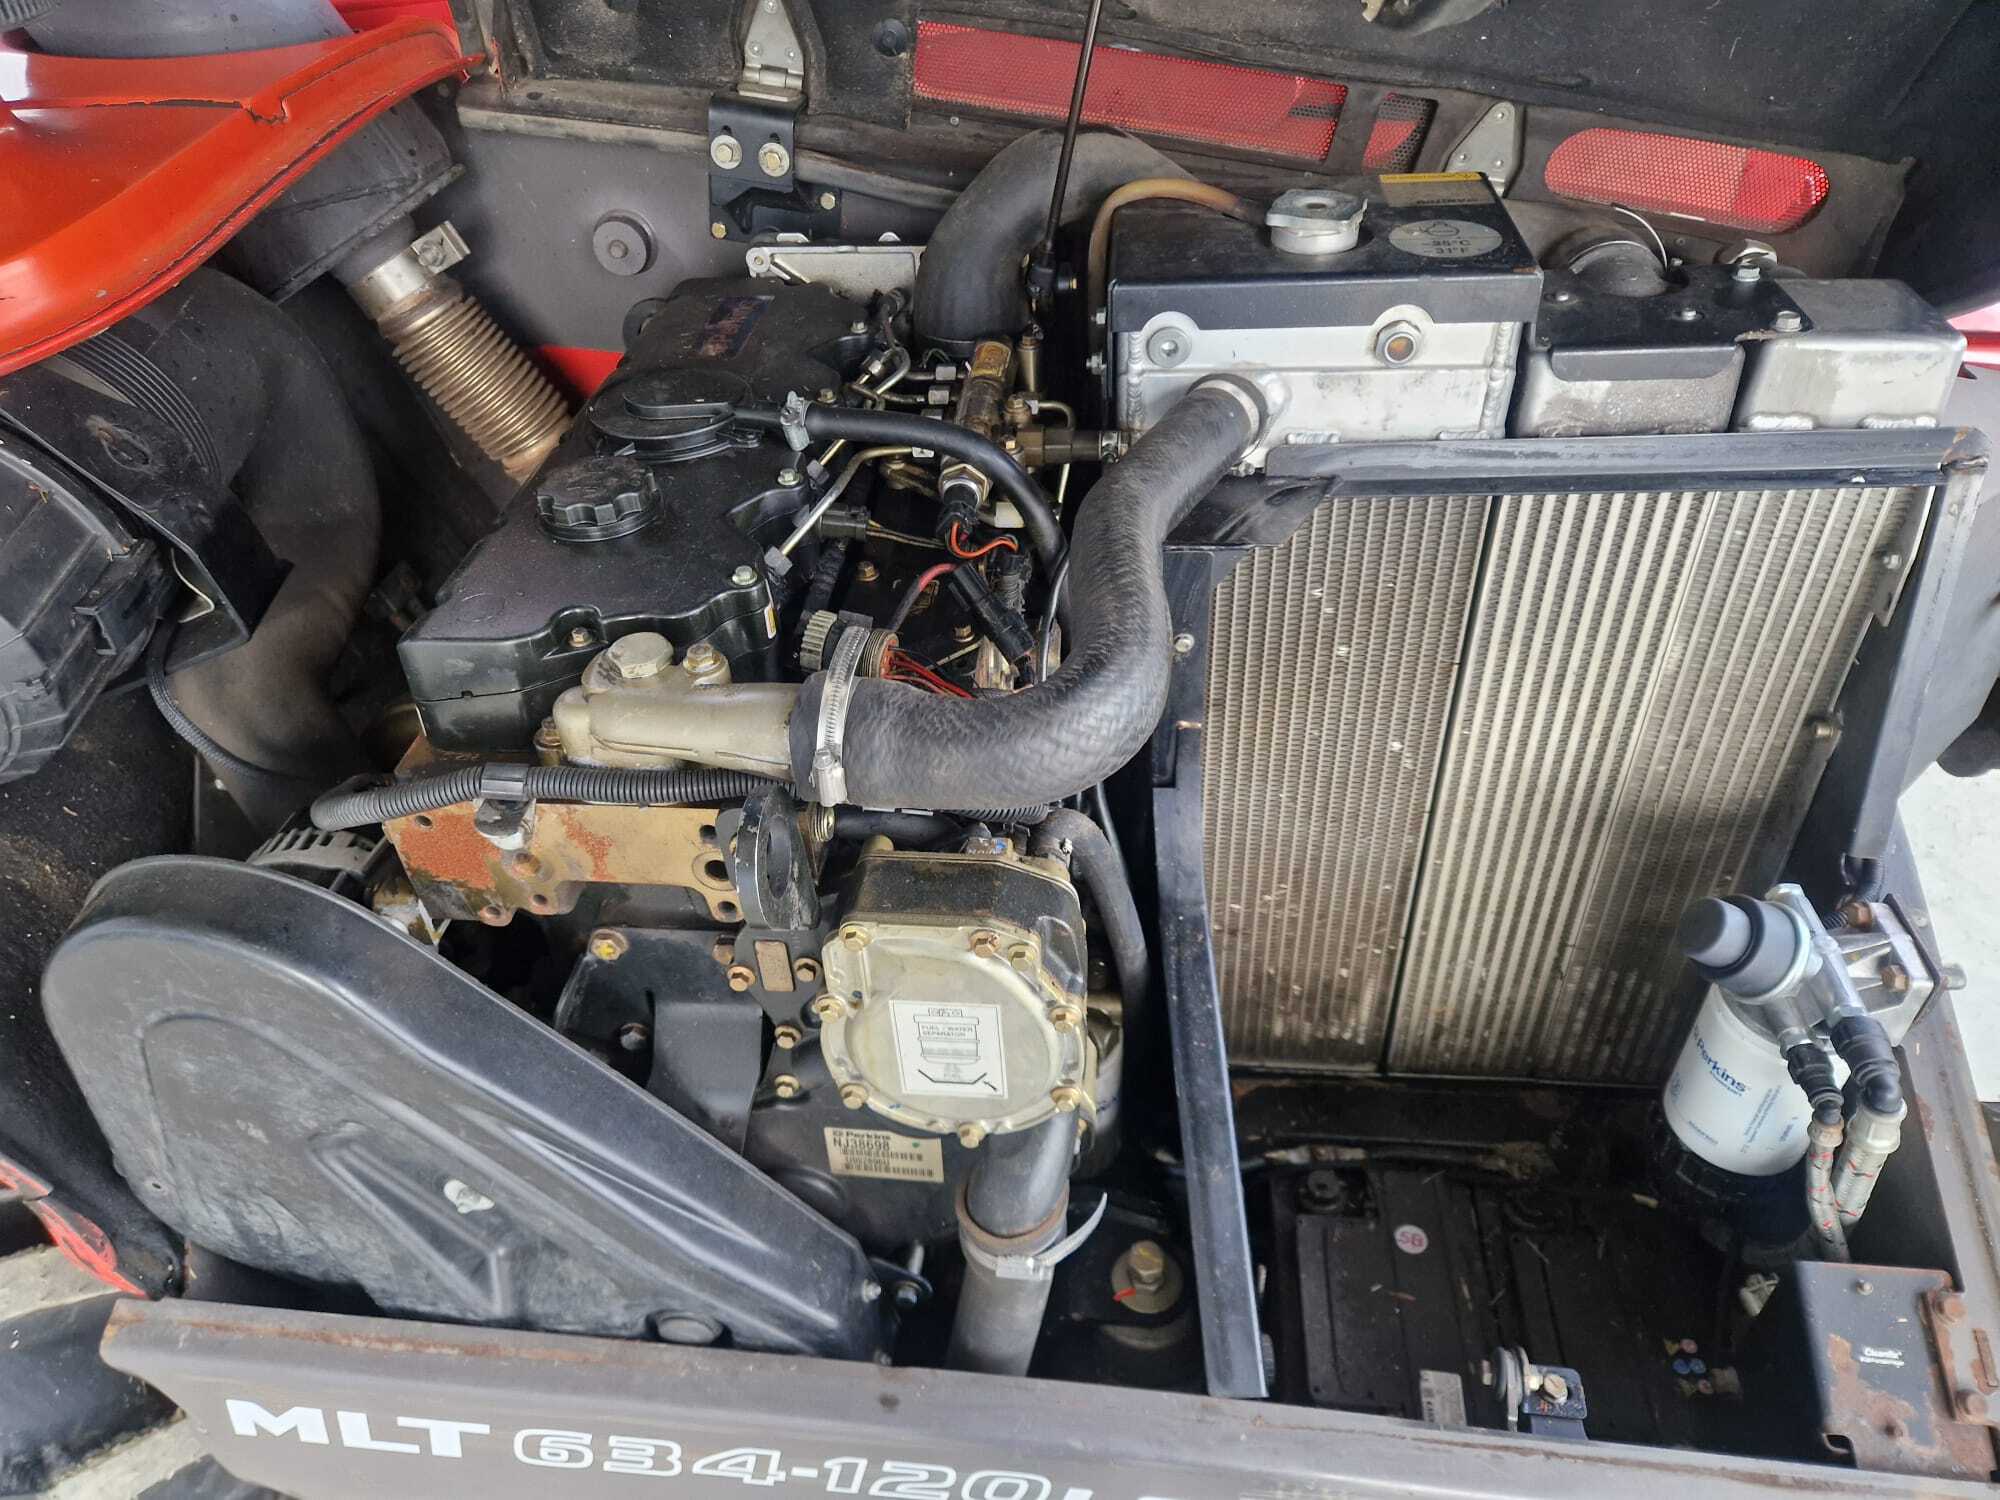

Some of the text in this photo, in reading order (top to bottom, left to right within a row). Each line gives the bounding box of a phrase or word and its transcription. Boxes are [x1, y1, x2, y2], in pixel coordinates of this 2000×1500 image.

[1696, 1037, 1746, 1093] Perkins
[833, 1137, 890, 1151] NJ38698
[846, 1130, 891, 1140] Perkins
[225, 1399, 490, 1458] MLT
